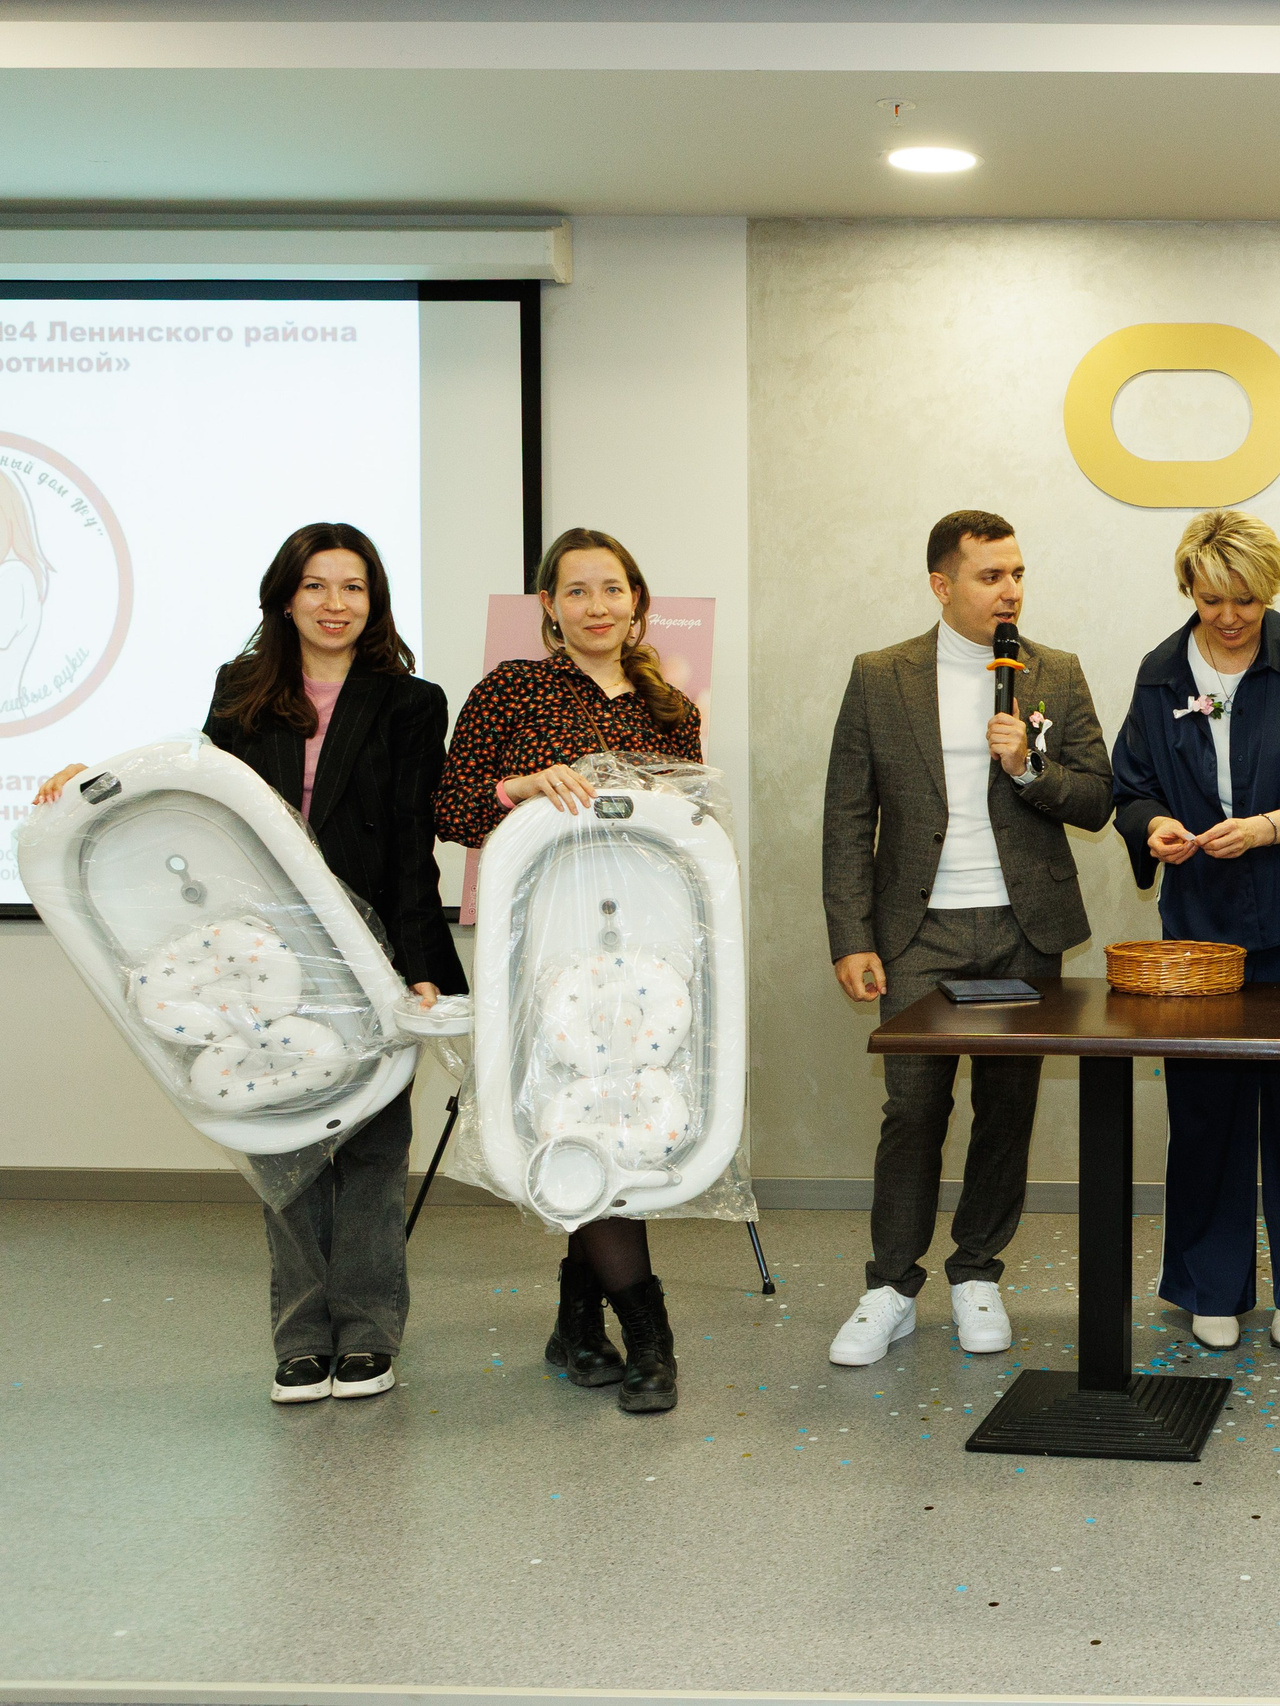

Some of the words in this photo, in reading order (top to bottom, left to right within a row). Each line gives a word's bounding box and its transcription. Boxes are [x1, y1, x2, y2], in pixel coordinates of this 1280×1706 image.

[47, 321, 233, 343] Ленинского
[244, 321, 357, 348] района
[0, 352, 131, 375] отиной»
[37, 472, 69, 498] дом
[648, 613, 703, 630] Надежда
[53, 647, 90, 693] руки
